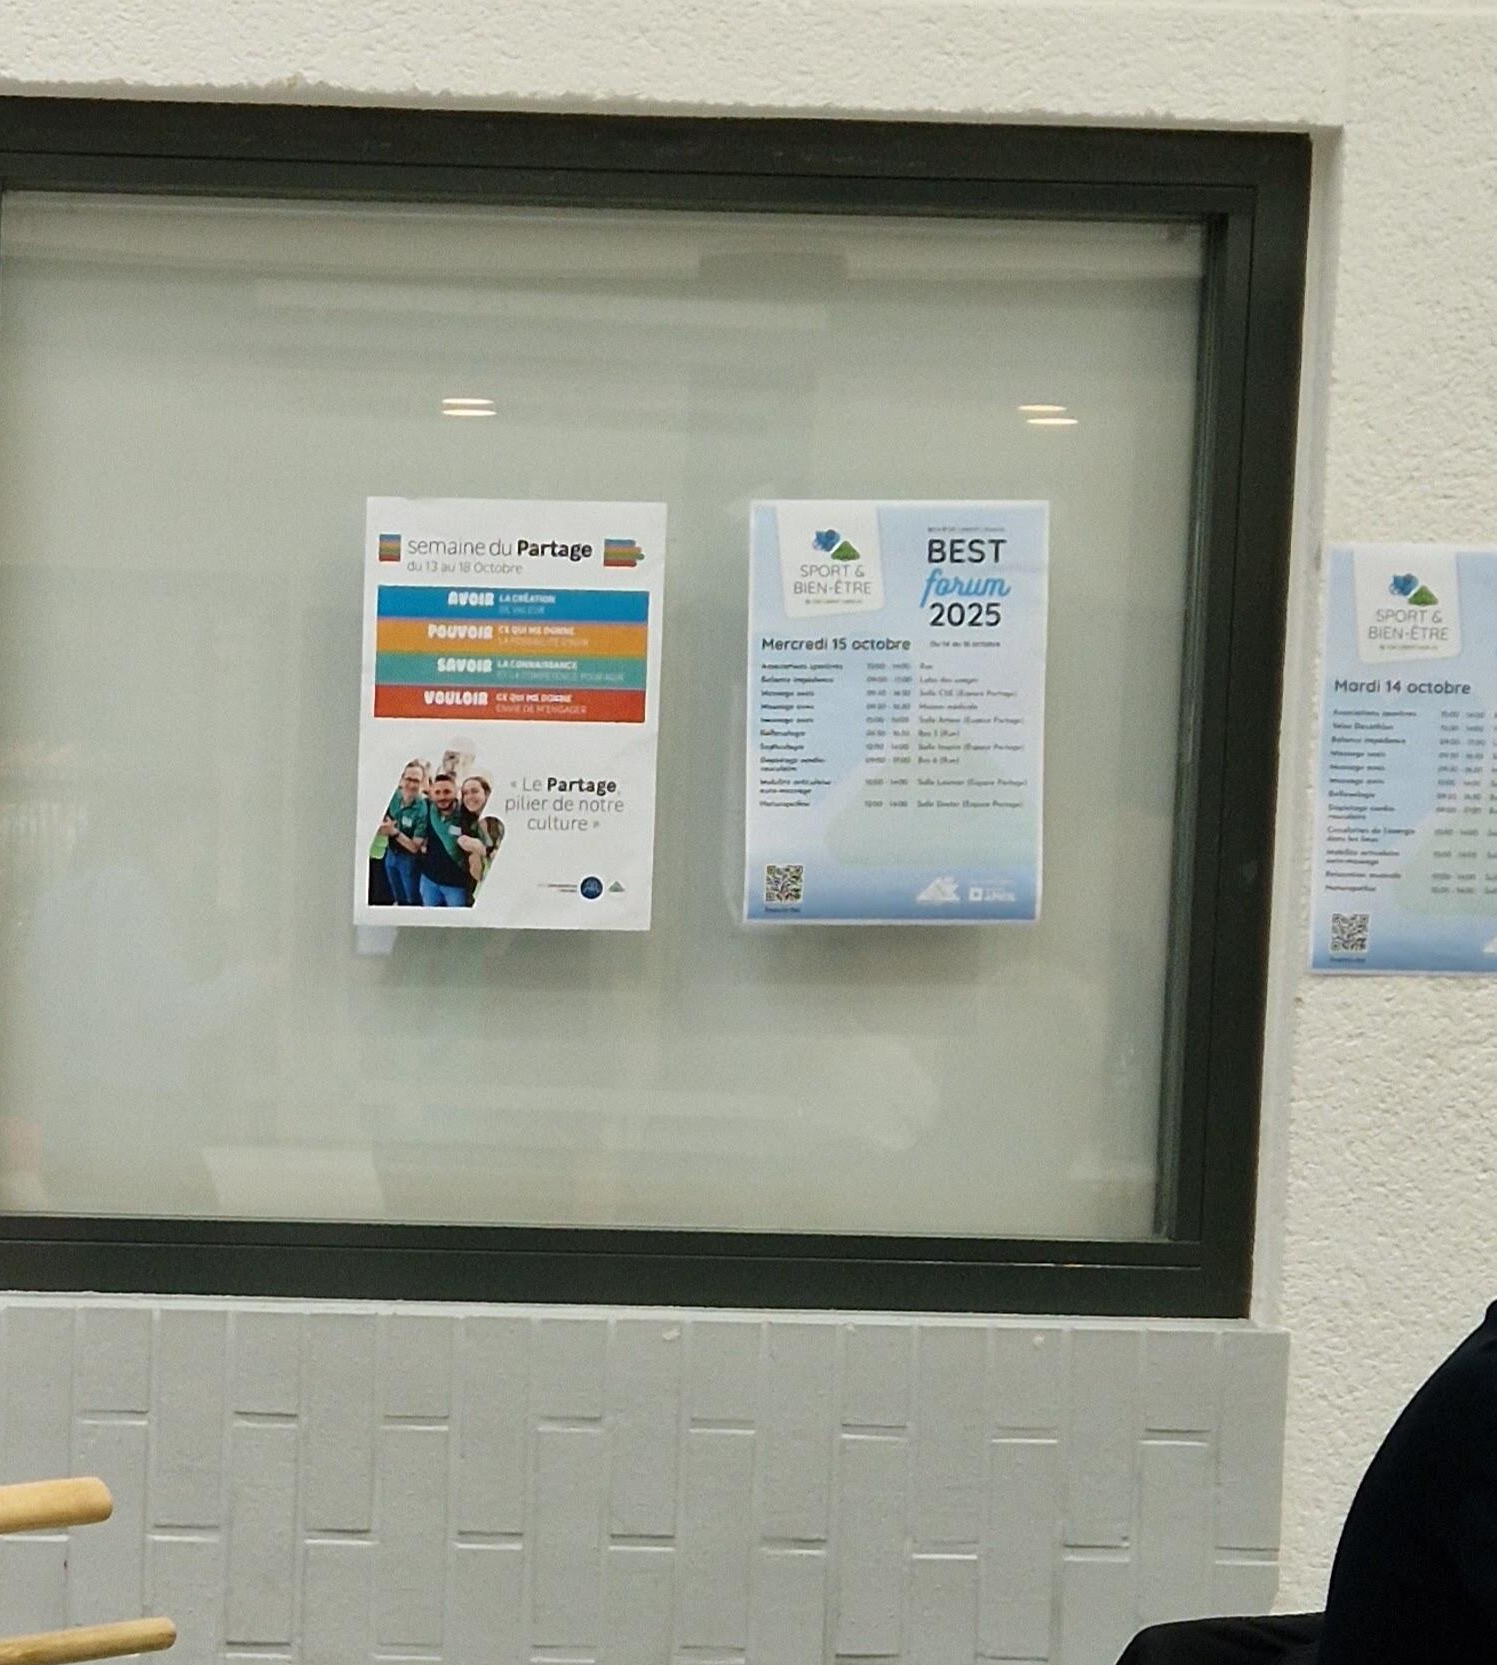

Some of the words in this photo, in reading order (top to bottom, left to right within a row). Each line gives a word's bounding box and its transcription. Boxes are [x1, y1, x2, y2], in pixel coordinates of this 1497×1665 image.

[408, 539, 485, 555] semaine
[489, 539, 511, 556] du
[517, 540, 592, 562] Partage
[928, 539, 1006, 563] BEST
[407, 561, 421, 572] du
[425, 562, 436, 572] 13
[441, 563, 455, 572] au
[460, 562, 470, 572] 18
[473, 562, 523, 574] Octobre
[801, 564, 849, 577] SPORT
[855, 566, 865, 578] &
[793, 580, 871, 595] BIEN-ÊTRE
[919, 569, 1010, 608] forum
[448, 591, 494, 606] AVOIR
[930, 602, 1001, 627] 2025
[1376, 609, 1426, 623] SPORT
[1432, 610, 1442, 624] &
[428, 624, 493, 639] POUVOIR
[1369, 625, 1448, 641] BIEN-ÊTRE
[762, 637, 828, 651] Mercredi
[833, 638, 847, 651] 15
[852, 638, 911, 651] octobre
[437, 658, 492, 673] SAVOIR
[1334, 679, 1380, 694] Mardi
[1385, 680, 1400, 693] 14
[1407, 681, 1471, 695] octobre
[424, 691, 488, 705] VOULOIR
[523, 777, 542, 792] Le
[505, 795, 548, 813] pilier
[553, 796, 574, 812] de
[579, 799, 624, 812] notre
[527, 815, 588, 831] culture
